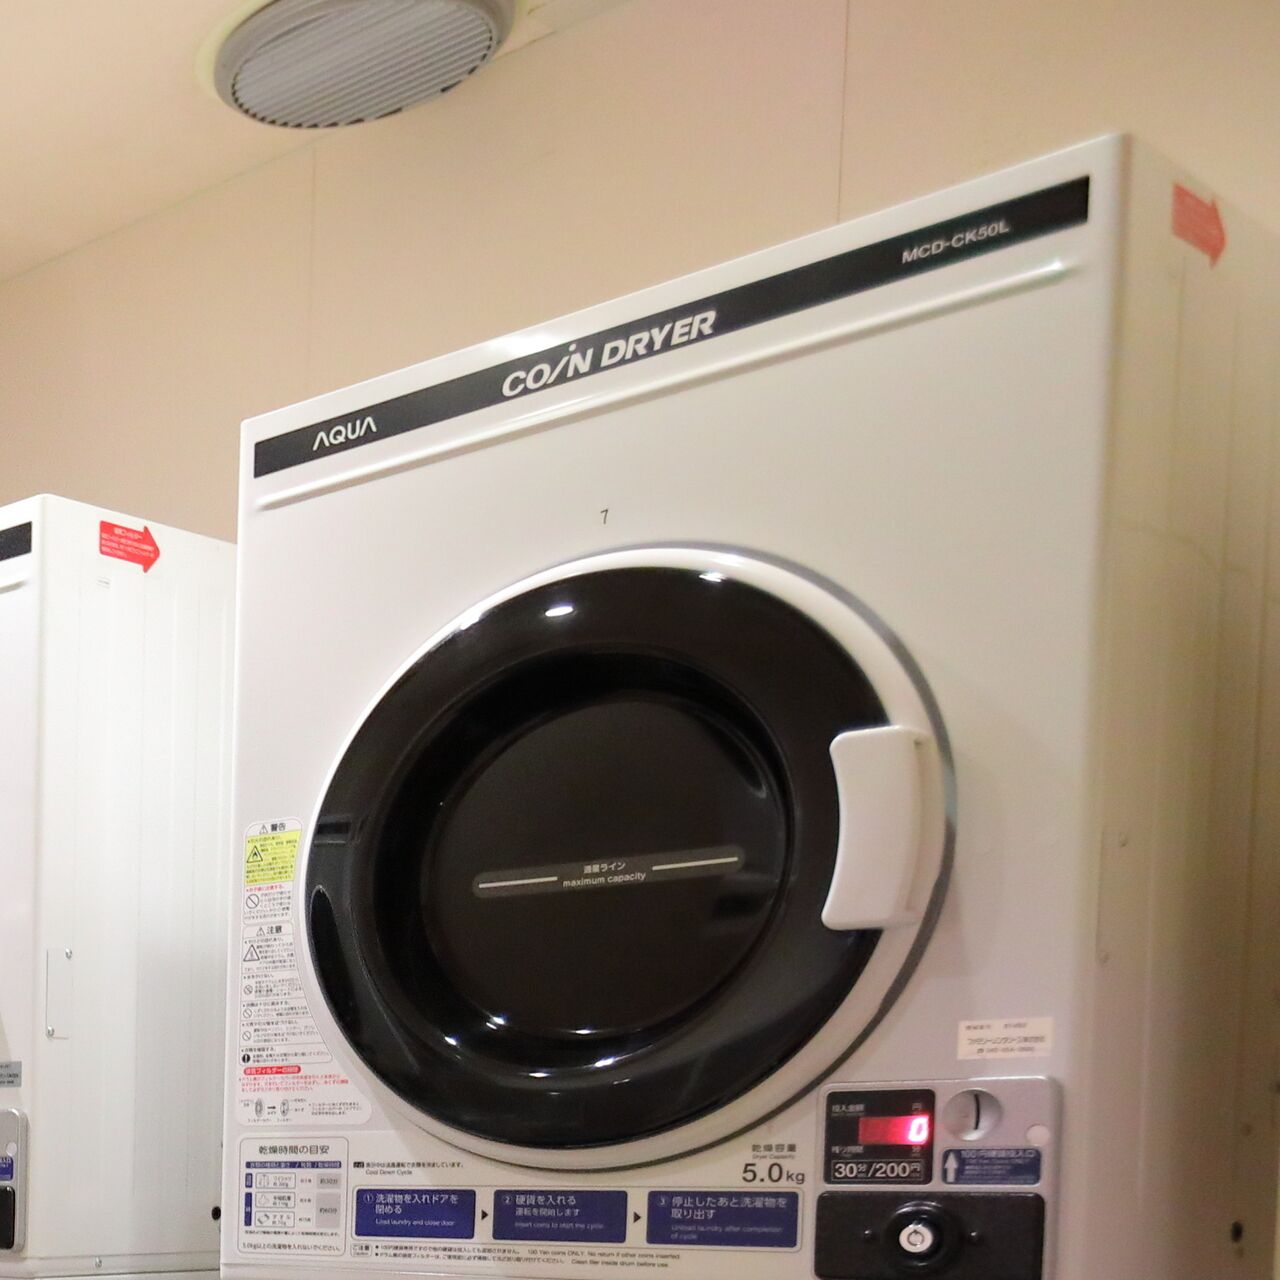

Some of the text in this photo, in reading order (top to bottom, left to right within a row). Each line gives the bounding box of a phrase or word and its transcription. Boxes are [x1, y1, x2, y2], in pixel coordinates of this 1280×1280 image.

[900, 218, 1011, 265] MCD-CK50L
[599, 309, 717, 371] DRYER
[311, 415, 378, 451] AQUA
[600, 509, 611, 525] 7
[562, 871, 647, 888] maximum capacity
[267, 925, 282, 934] 注意
[907, 1117, 928, 1143] 0
[258, 1144, 330, 1155] 乾燥時間の目安
[751, 1143, 797, 1153] 乾燥容量
[376, 1193, 459, 1204] 洗濯物を入れドアを
[515, 1194, 577, 1206] 硬貨を入れる
[671, 1196, 788, 1208] 停止したあと洗濯物を
[375, 1204, 402, 1215] 閉める
[671, 1209, 716, 1219] 取り出す
